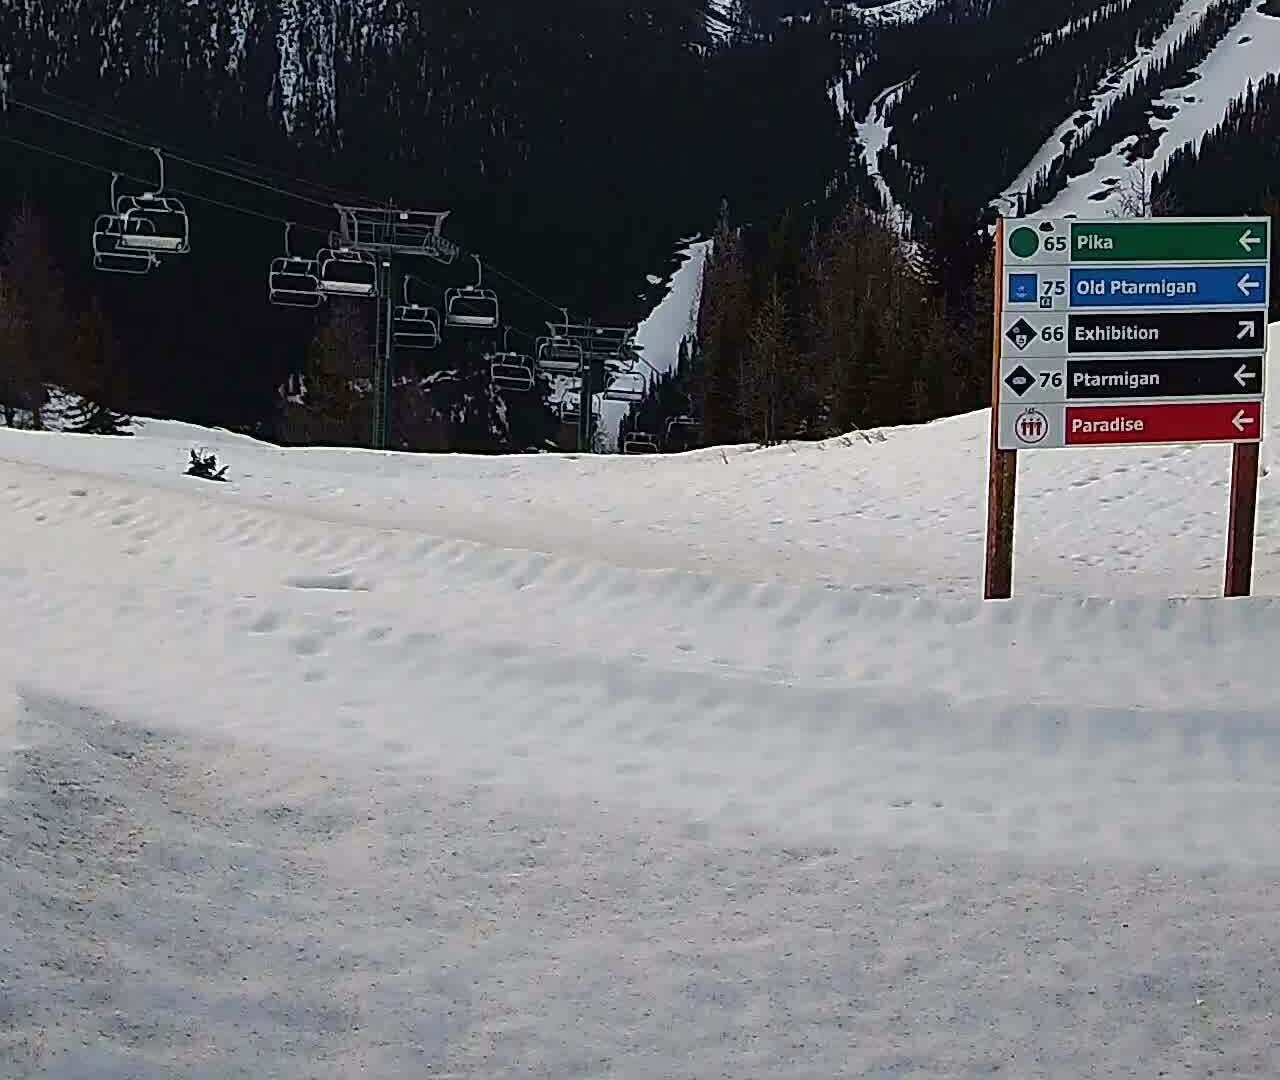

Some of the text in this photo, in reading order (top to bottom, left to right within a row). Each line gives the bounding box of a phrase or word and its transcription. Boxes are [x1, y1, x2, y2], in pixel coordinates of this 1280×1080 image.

[1043, 234, 1113, 251] 65 Pika
[1042, 277, 1197, 298] 75 Old Ptarmigan
[1040, 324, 1159, 342] 66 Exhibition
[1039, 370, 1160, 390] 76 Ptarmigan
[1071, 413, 1144, 432] Paradise
